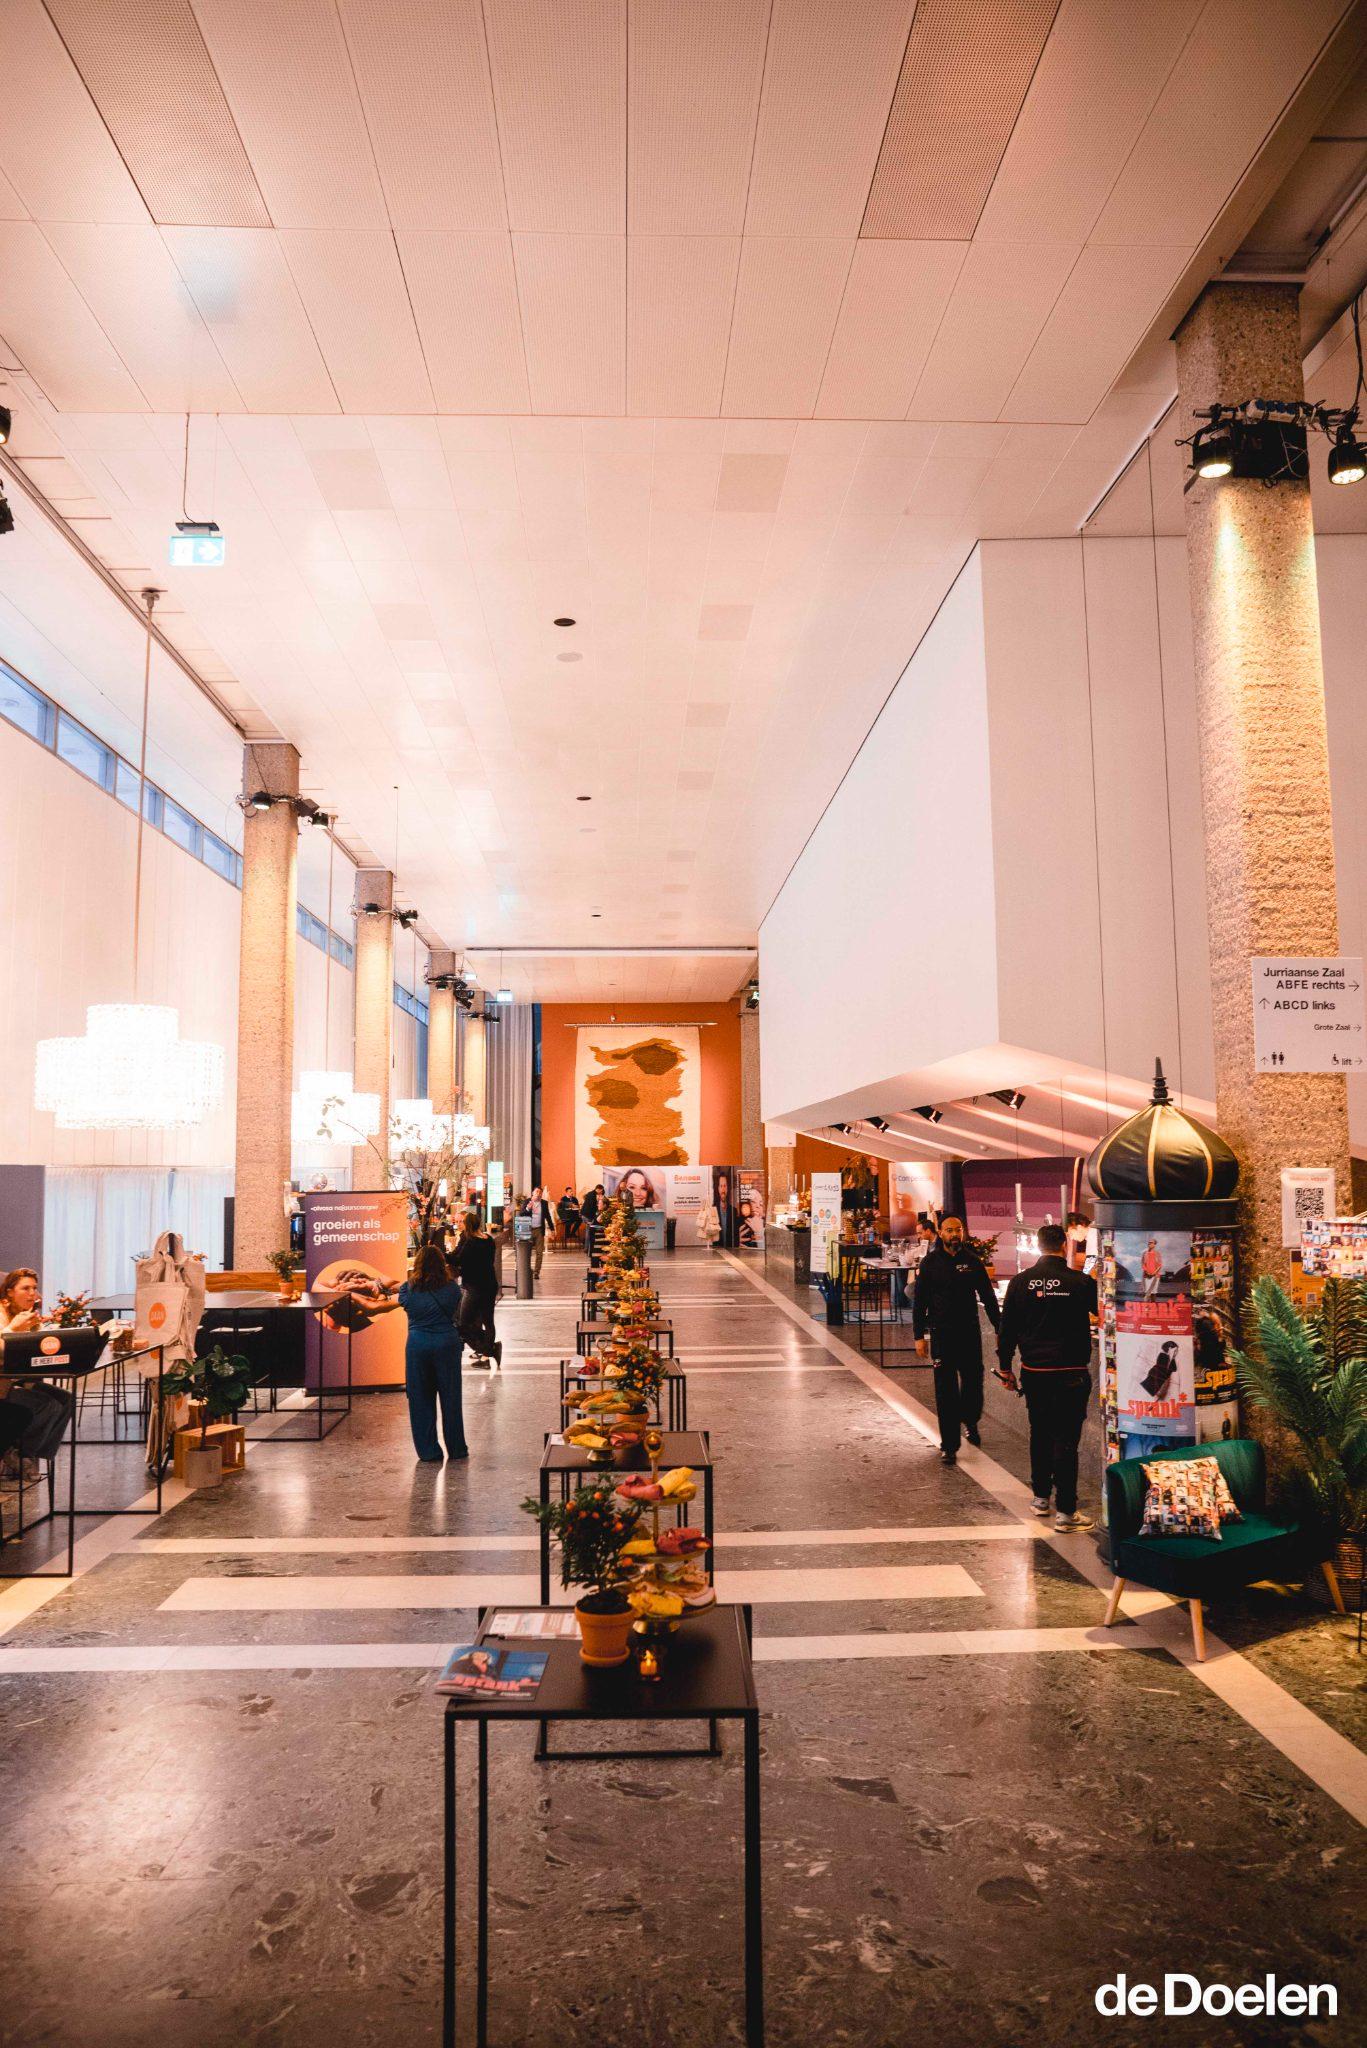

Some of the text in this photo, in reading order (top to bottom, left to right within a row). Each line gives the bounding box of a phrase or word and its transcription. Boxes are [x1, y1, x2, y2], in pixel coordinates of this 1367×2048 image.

[1263, 967, 1345, 977] Jurriaanse Zaal
[1276, 980, 1346, 989] ABFE rechts
[1273, 1001, 1336, 1010] ABCD links
[980, 1203, 1012, 1217] Maak
[313, 1219, 381, 1233] groeien als
[313, 1231, 400, 1246] gemeenschap
[1118, 1398, 1194, 1420] sprank
